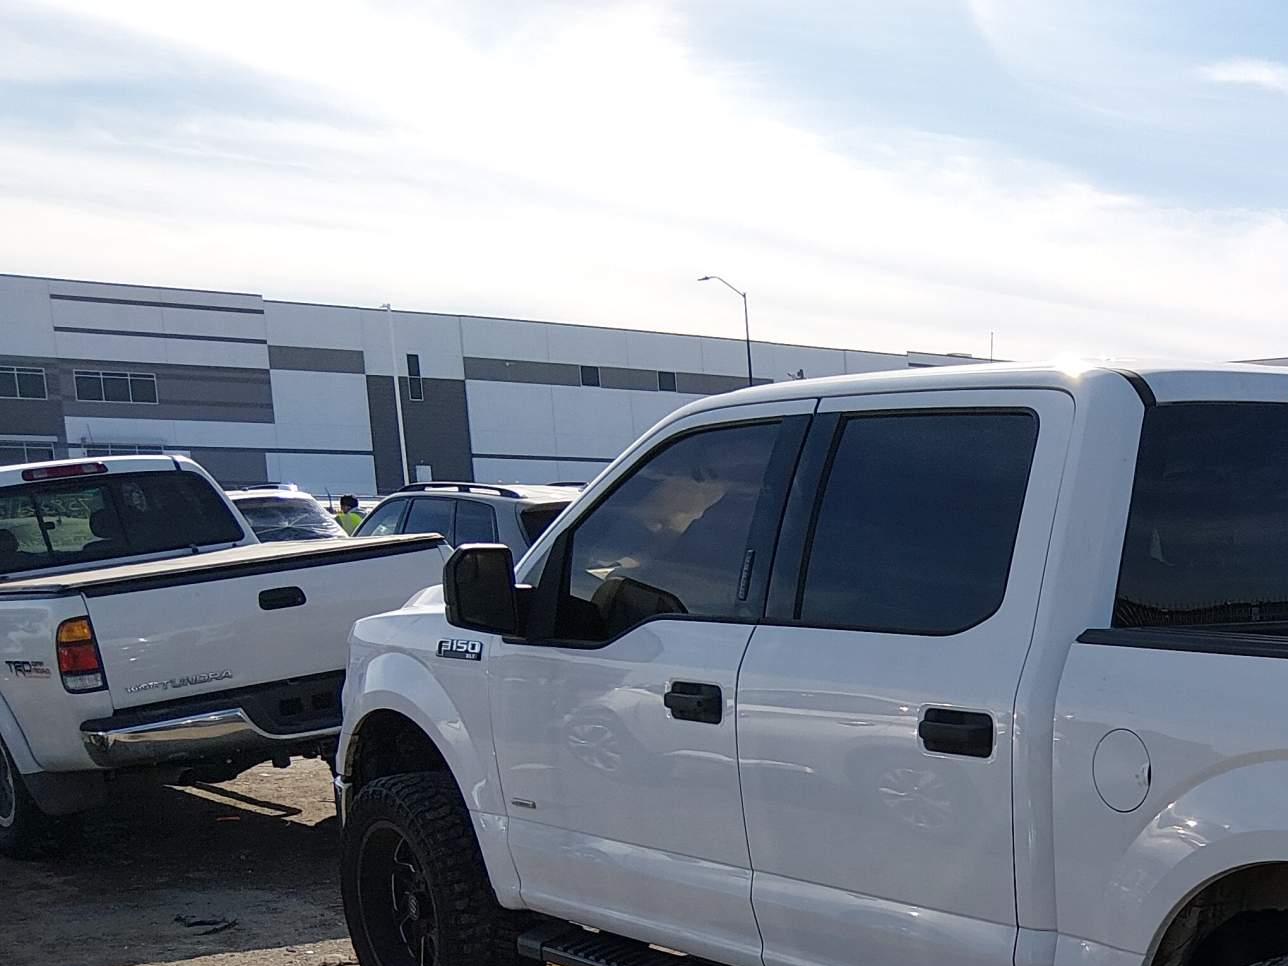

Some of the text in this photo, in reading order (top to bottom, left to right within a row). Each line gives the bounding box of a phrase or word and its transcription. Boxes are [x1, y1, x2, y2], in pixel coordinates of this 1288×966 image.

[437, 639, 481, 657] F150
[5, 661, 32, 677] TRD
[159, 670, 232, 690] TUNDRA
